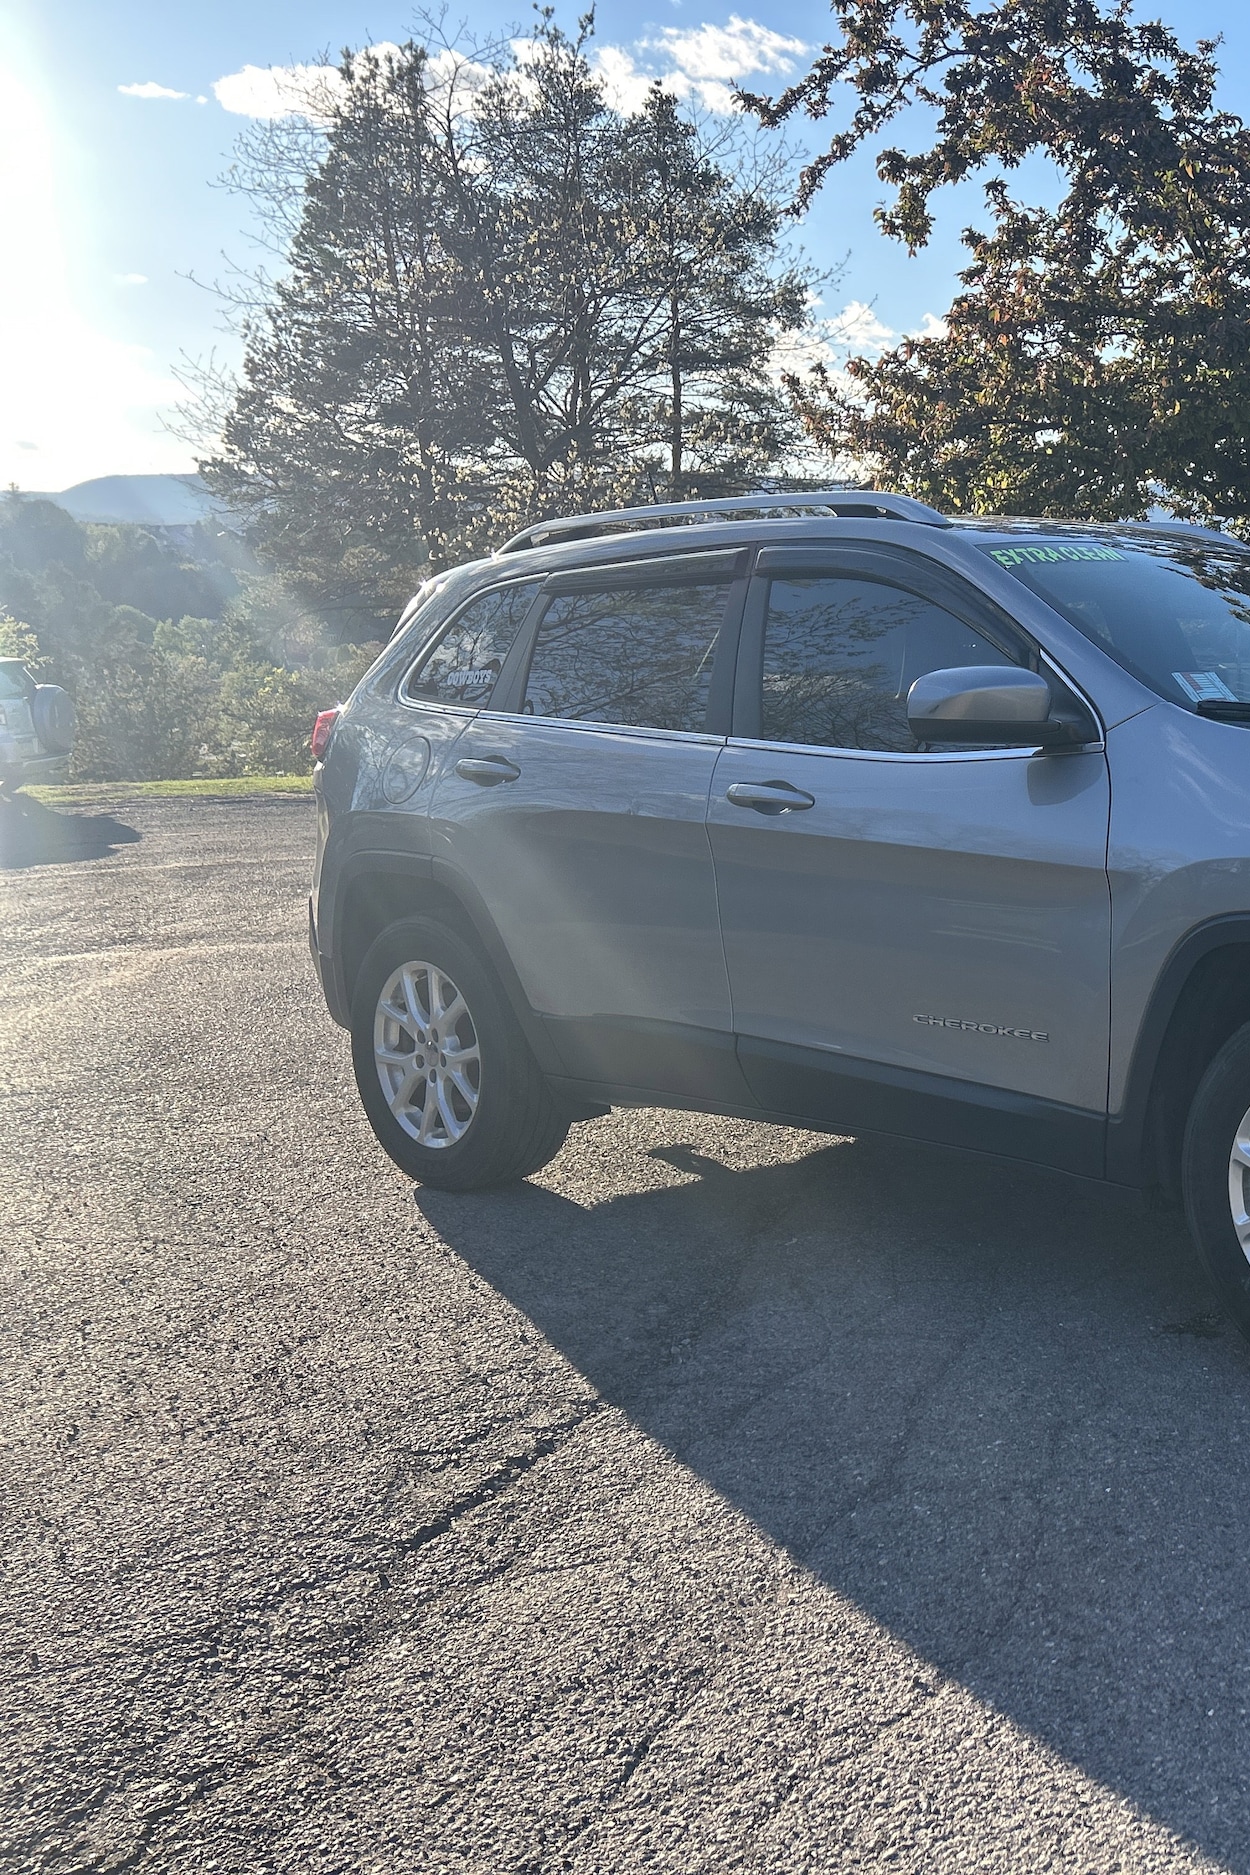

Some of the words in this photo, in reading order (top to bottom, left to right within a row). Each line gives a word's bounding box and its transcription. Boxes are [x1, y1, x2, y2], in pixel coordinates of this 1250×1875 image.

[990, 546, 1066, 566] EXTRA
[1058, 546, 1127, 561] CLEAN
[446, 669, 492, 687] COWBOYS
[912, 1013, 1050, 1043] CHEROKEE
